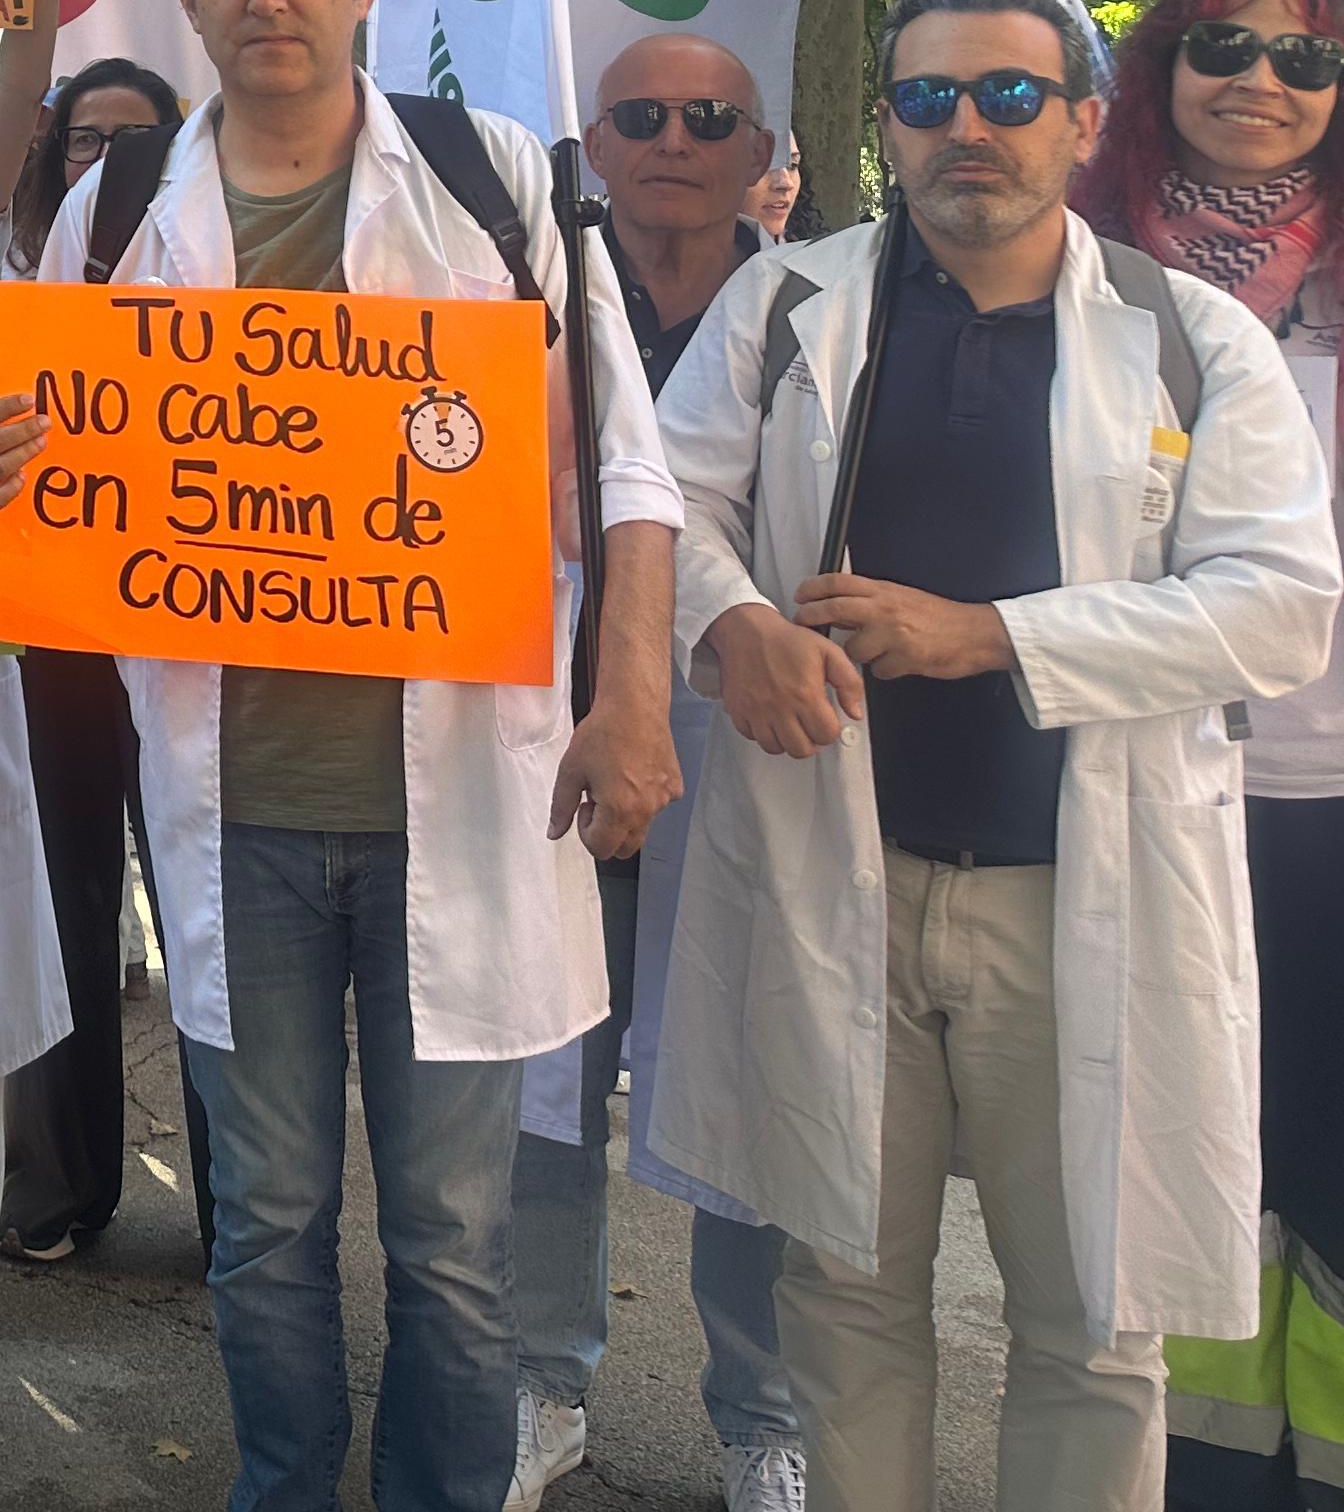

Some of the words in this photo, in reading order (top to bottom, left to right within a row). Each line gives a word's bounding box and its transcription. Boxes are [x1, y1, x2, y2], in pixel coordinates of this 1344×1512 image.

[234, 302, 447, 383] Salud
[35, 370, 129, 436] NO
[435, 418, 454, 447] 5
[33, 465, 127, 534] en
[363, 454, 446, 549] de
[119, 549, 449, 635] CONSULTA
